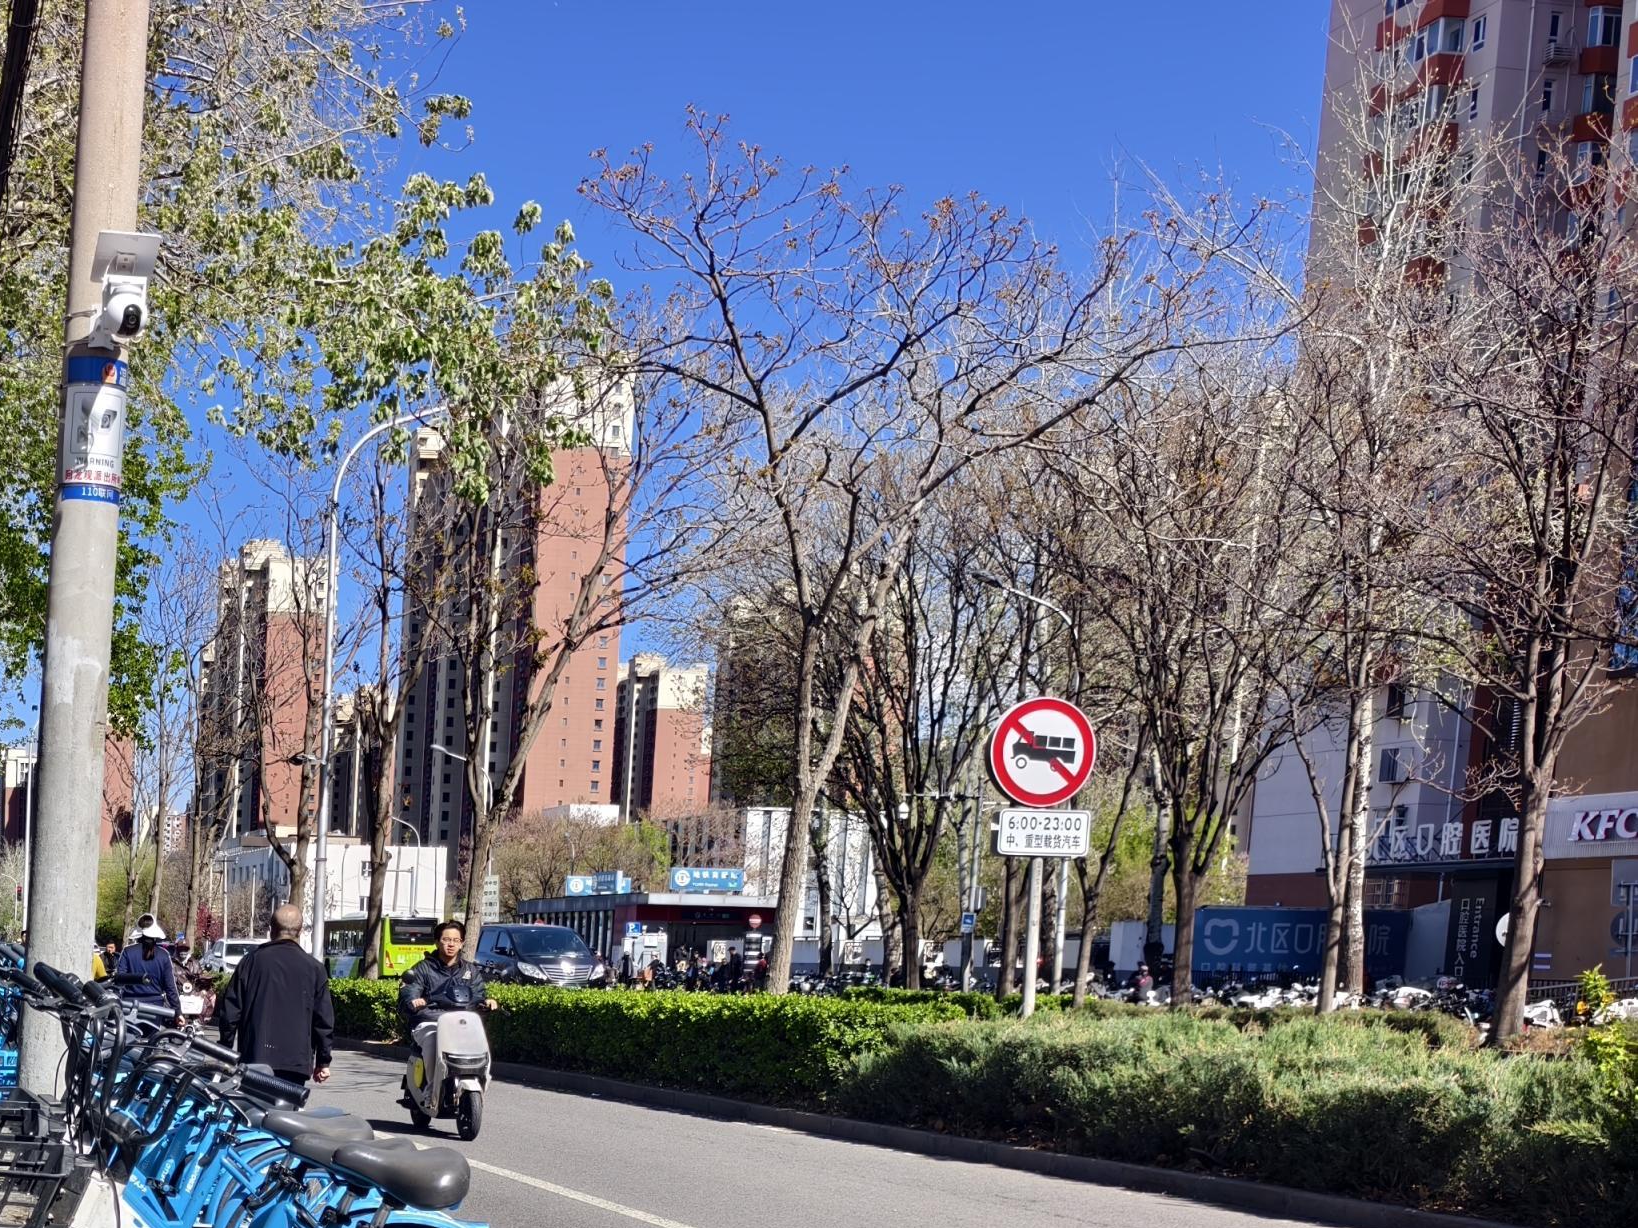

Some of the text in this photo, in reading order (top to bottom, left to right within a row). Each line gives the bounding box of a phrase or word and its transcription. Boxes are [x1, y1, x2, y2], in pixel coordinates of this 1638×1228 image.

[1567, 808, 1638, 842] KFC
[1244, 921, 1391, 956] 北区口院
[1469, 897, 1486, 959] Entrance
